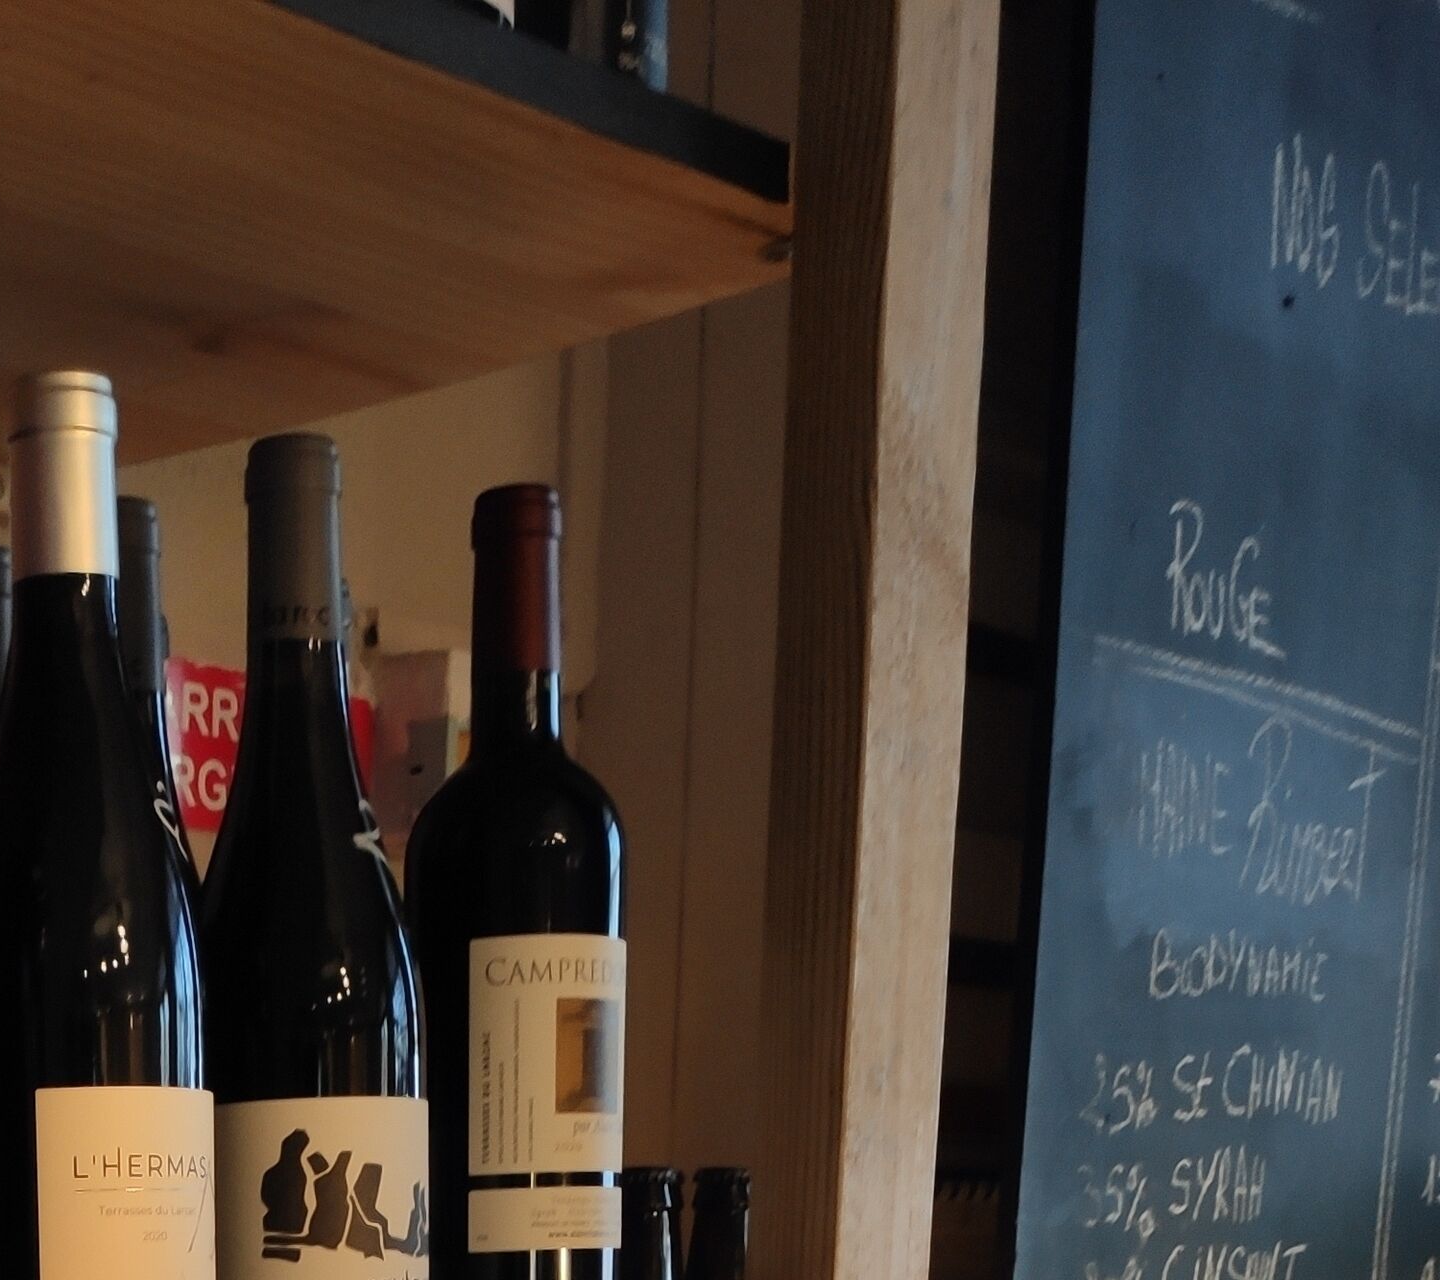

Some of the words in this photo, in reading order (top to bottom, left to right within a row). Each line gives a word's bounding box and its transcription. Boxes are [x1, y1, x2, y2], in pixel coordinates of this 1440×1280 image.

[164, 680, 242, 743] RR
[171, 755, 236, 812] RG
[72, 1147, 208, 1181] L'HERMAS
[1169, 1145, 1266, 1224] SYRAH
